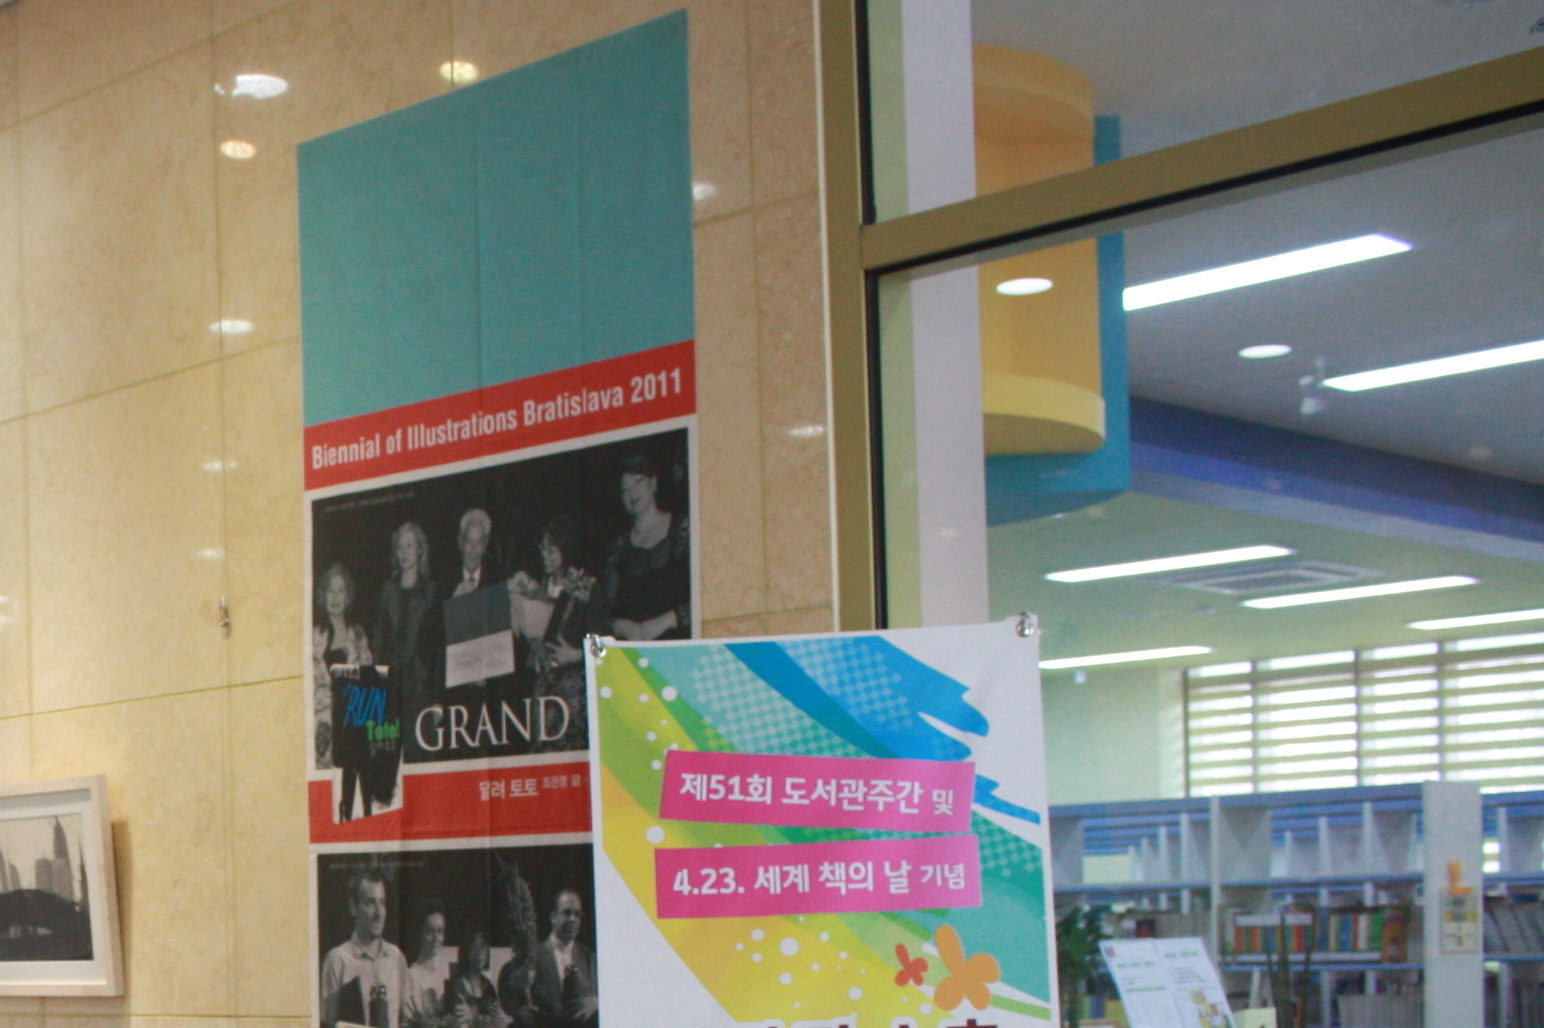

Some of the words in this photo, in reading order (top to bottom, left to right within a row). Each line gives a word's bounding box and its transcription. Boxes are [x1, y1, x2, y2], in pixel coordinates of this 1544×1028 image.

[311, 432, 381, 471] Biennial
[385, 428, 403, 456] of
[407, 406, 518, 450] Illustrations
[523, 385, 624, 427] Bratislava
[630, 367, 682, 403] 2011
[415, 695, 570, 751] GRAND
[478, 779, 506, 802] 달려
[509, 777, 539, 799] 토토
[680, 772, 772, 805] 제51회
[782, 776, 923, 815] 도서관주간
[932, 788, 954, 816] 및
[673, 867, 745, 896] 4.23.
[755, 863, 810, 895] 세계
[818, 861, 874, 896] 책의
[883, 860, 912, 895] 날
[920, 863, 965, 890] 기념
